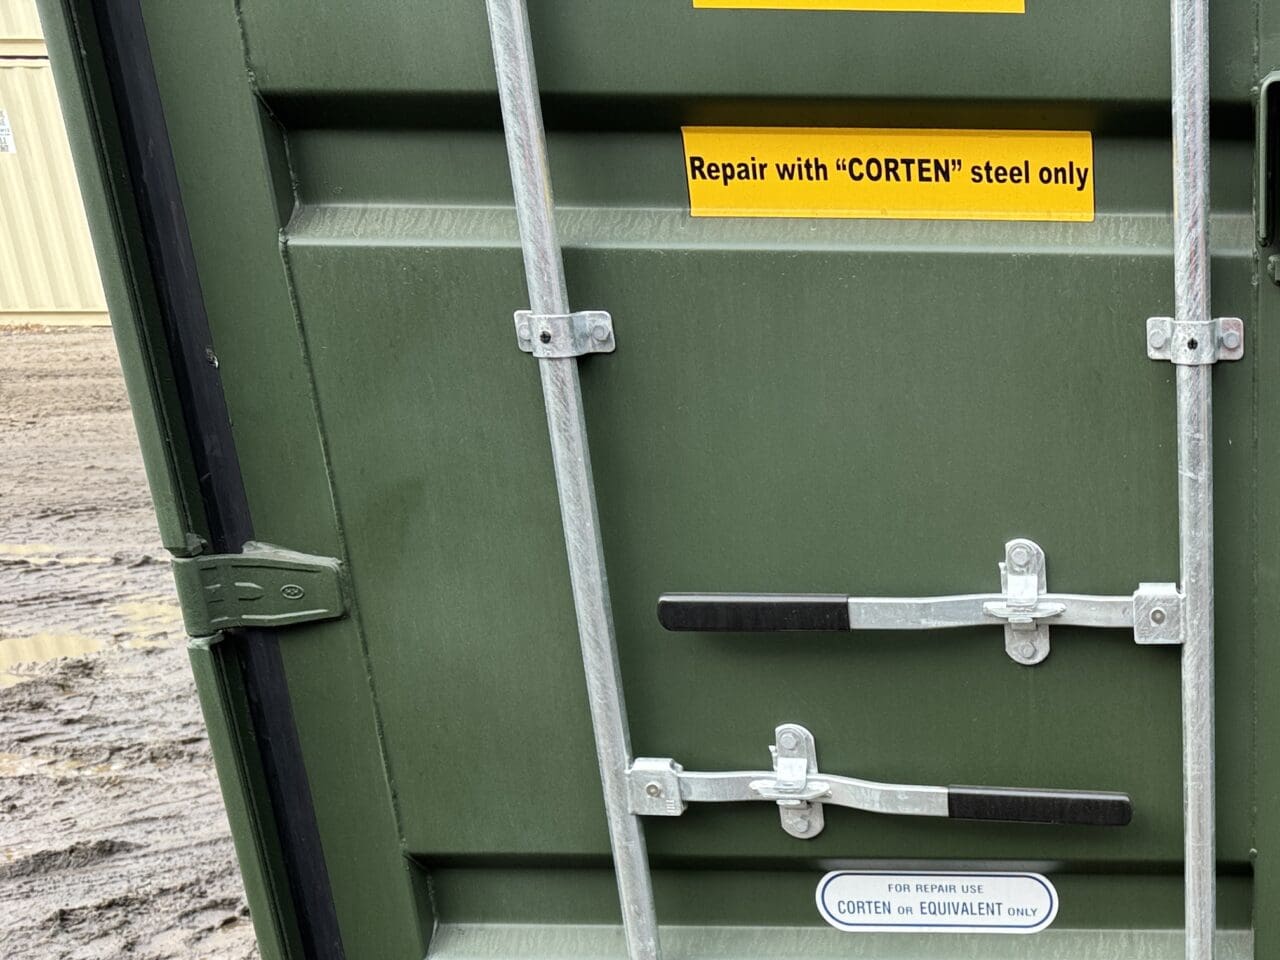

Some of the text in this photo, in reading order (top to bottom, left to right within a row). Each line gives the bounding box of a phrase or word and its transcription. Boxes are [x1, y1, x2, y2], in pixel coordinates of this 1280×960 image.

[688, 156, 1090, 191] Repair with “CORTEN” steel only
[887, 883, 985, 894] FOR REPAIR USE
[837, 900, 1038, 917] CORTEN OR EQUIVALENT ONLY
